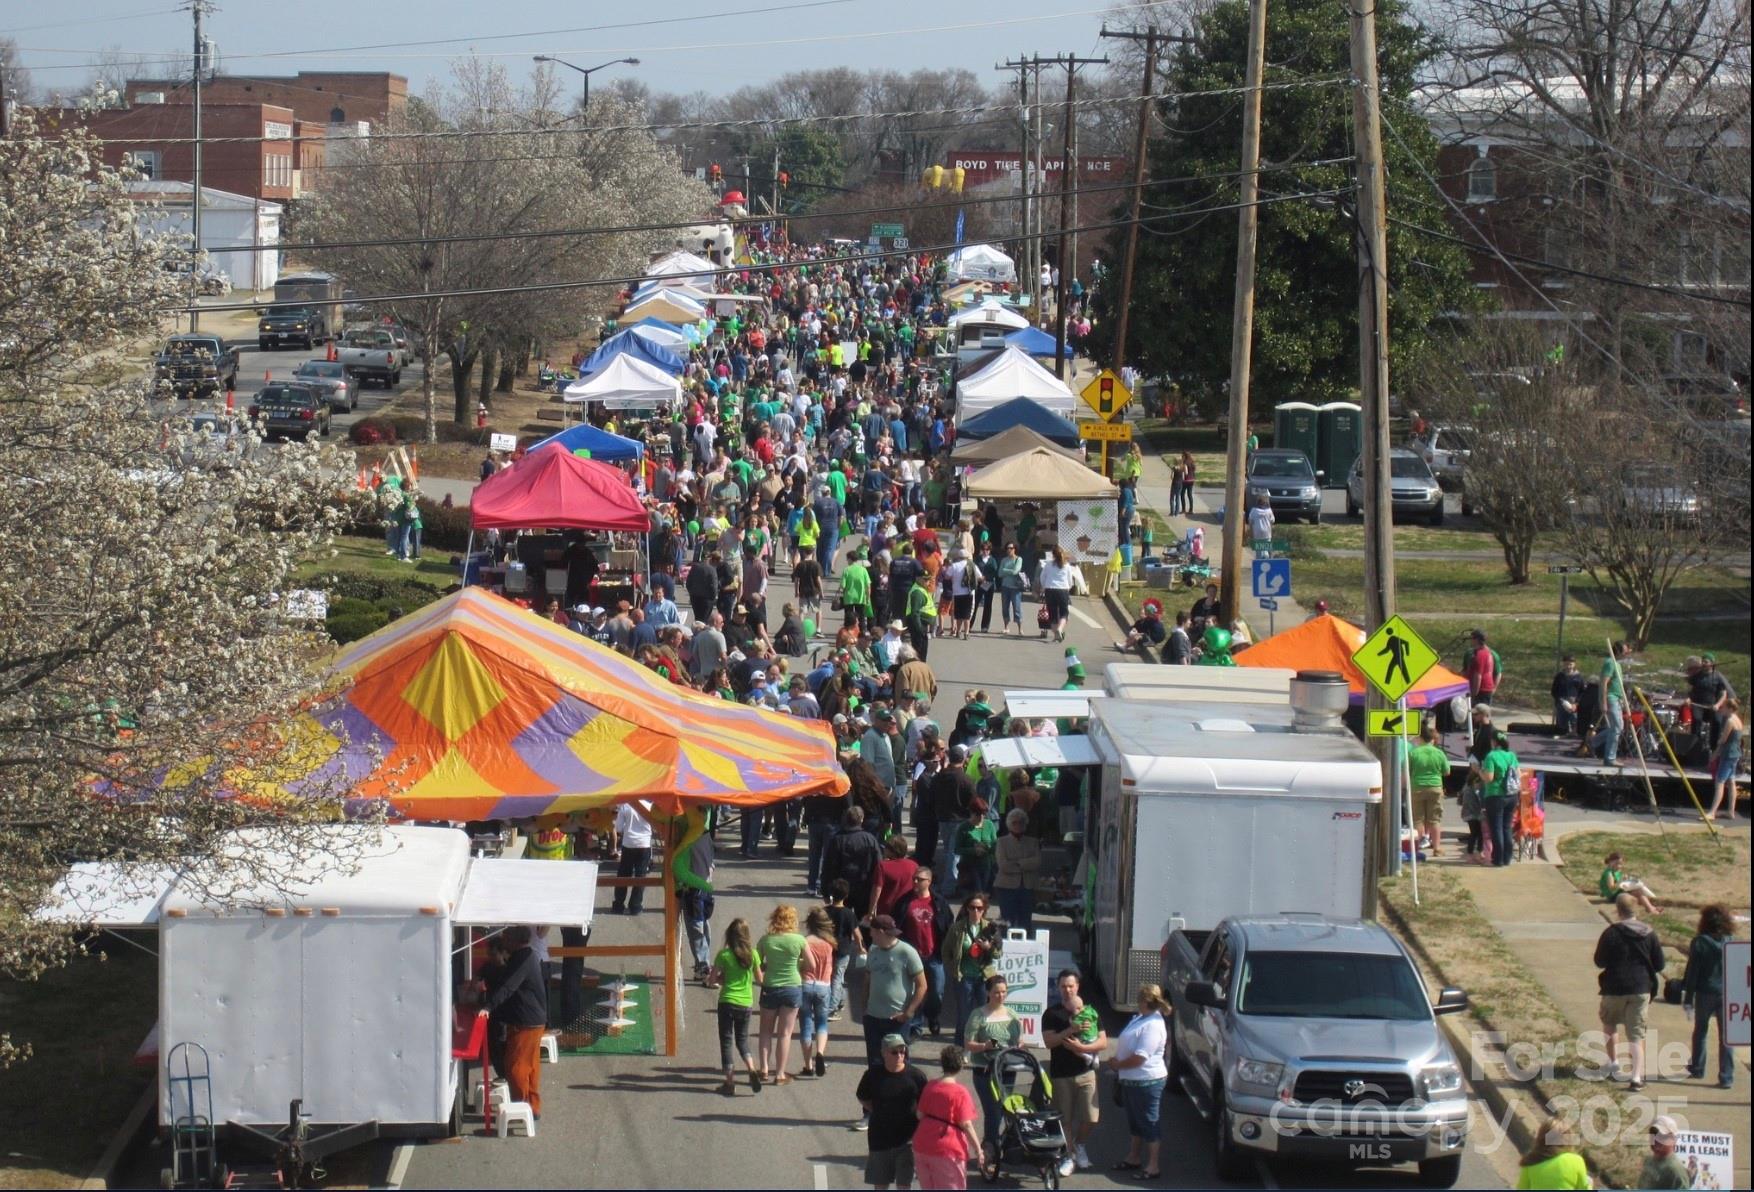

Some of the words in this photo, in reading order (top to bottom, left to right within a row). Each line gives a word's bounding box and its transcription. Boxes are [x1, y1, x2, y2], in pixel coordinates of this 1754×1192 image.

[955, 160, 987, 170] BOYD
[1028, 160, 1035, 170] &
[997, 954, 1044, 971] LOVER
[1701, 1135, 1730, 1145] MUST
[1698, 1146, 1729, 1157] LEASH
